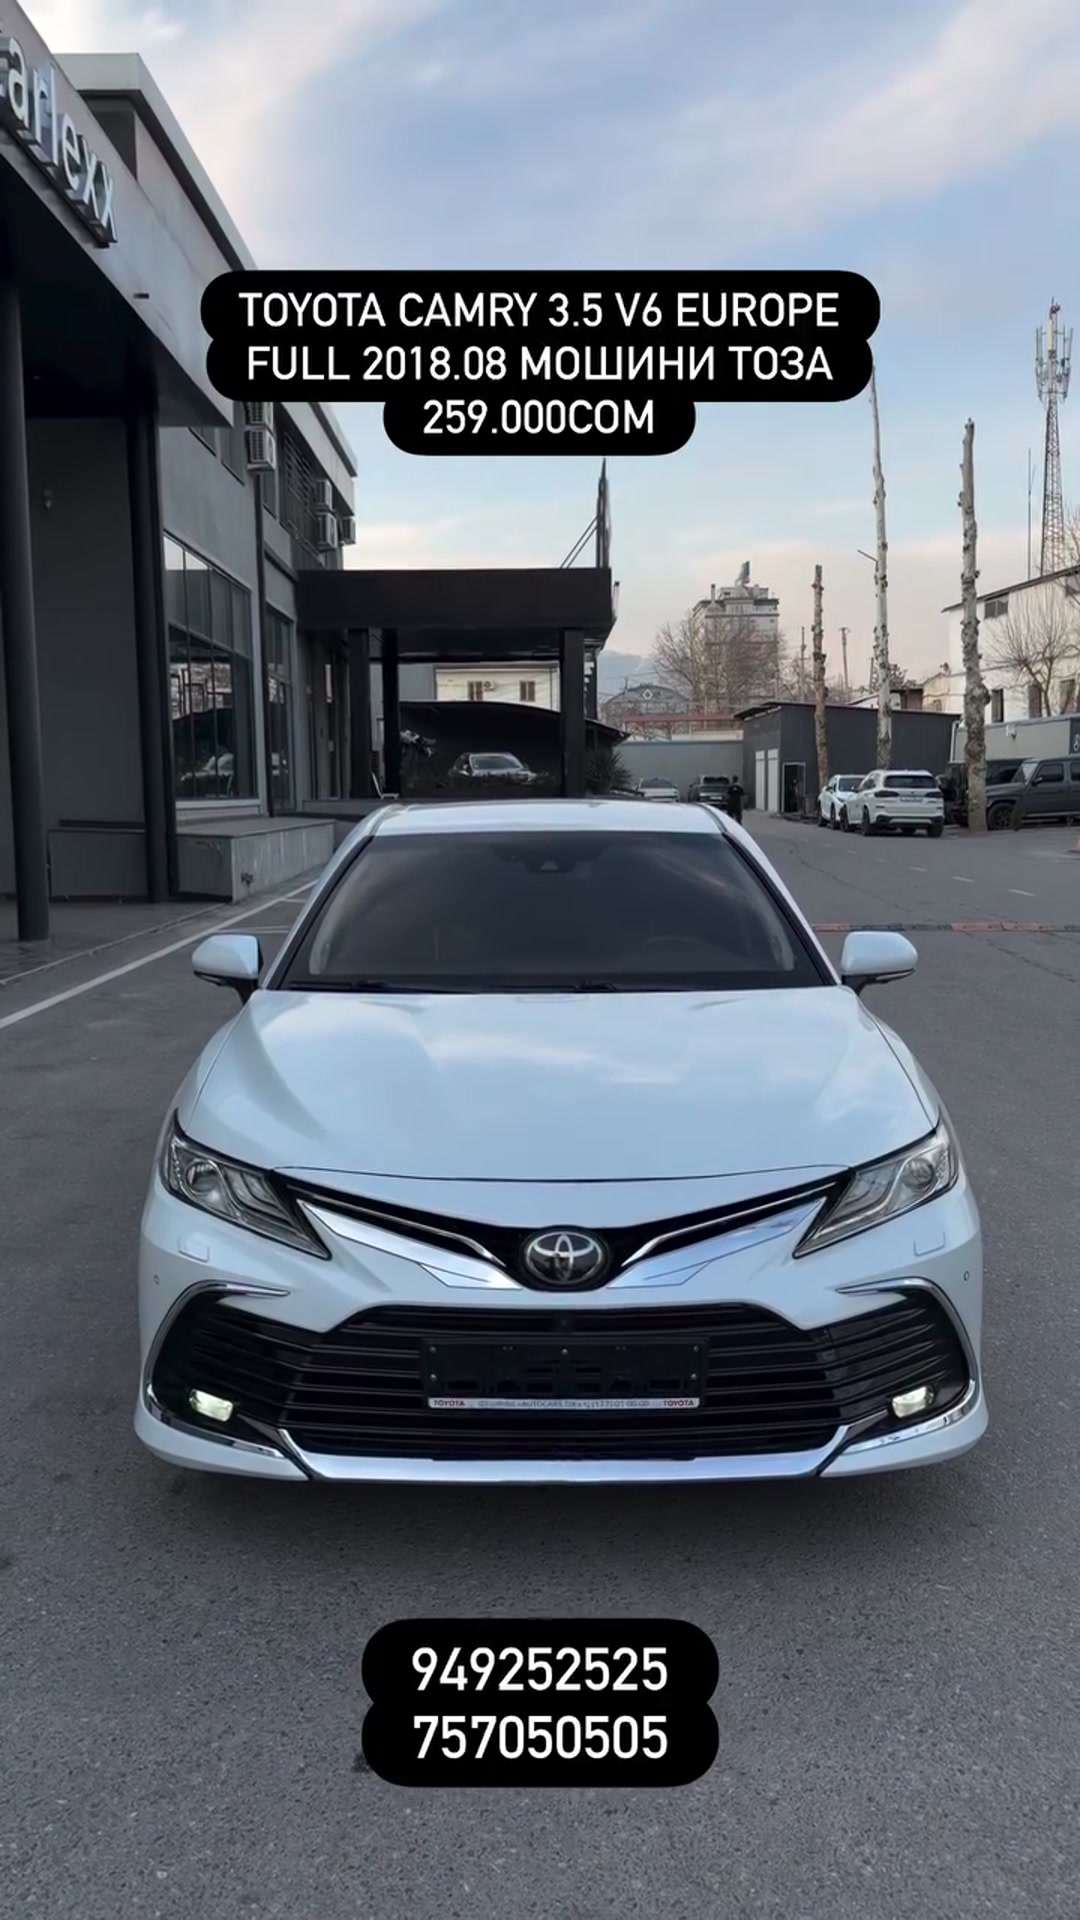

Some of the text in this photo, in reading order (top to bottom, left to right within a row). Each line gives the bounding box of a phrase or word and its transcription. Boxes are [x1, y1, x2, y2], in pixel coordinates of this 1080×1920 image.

[0, 36, 117, 243] arlexx
[433, 1399, 465, 1407] TOYOTA
[663, 1399, 694, 1407] TOYOTA
